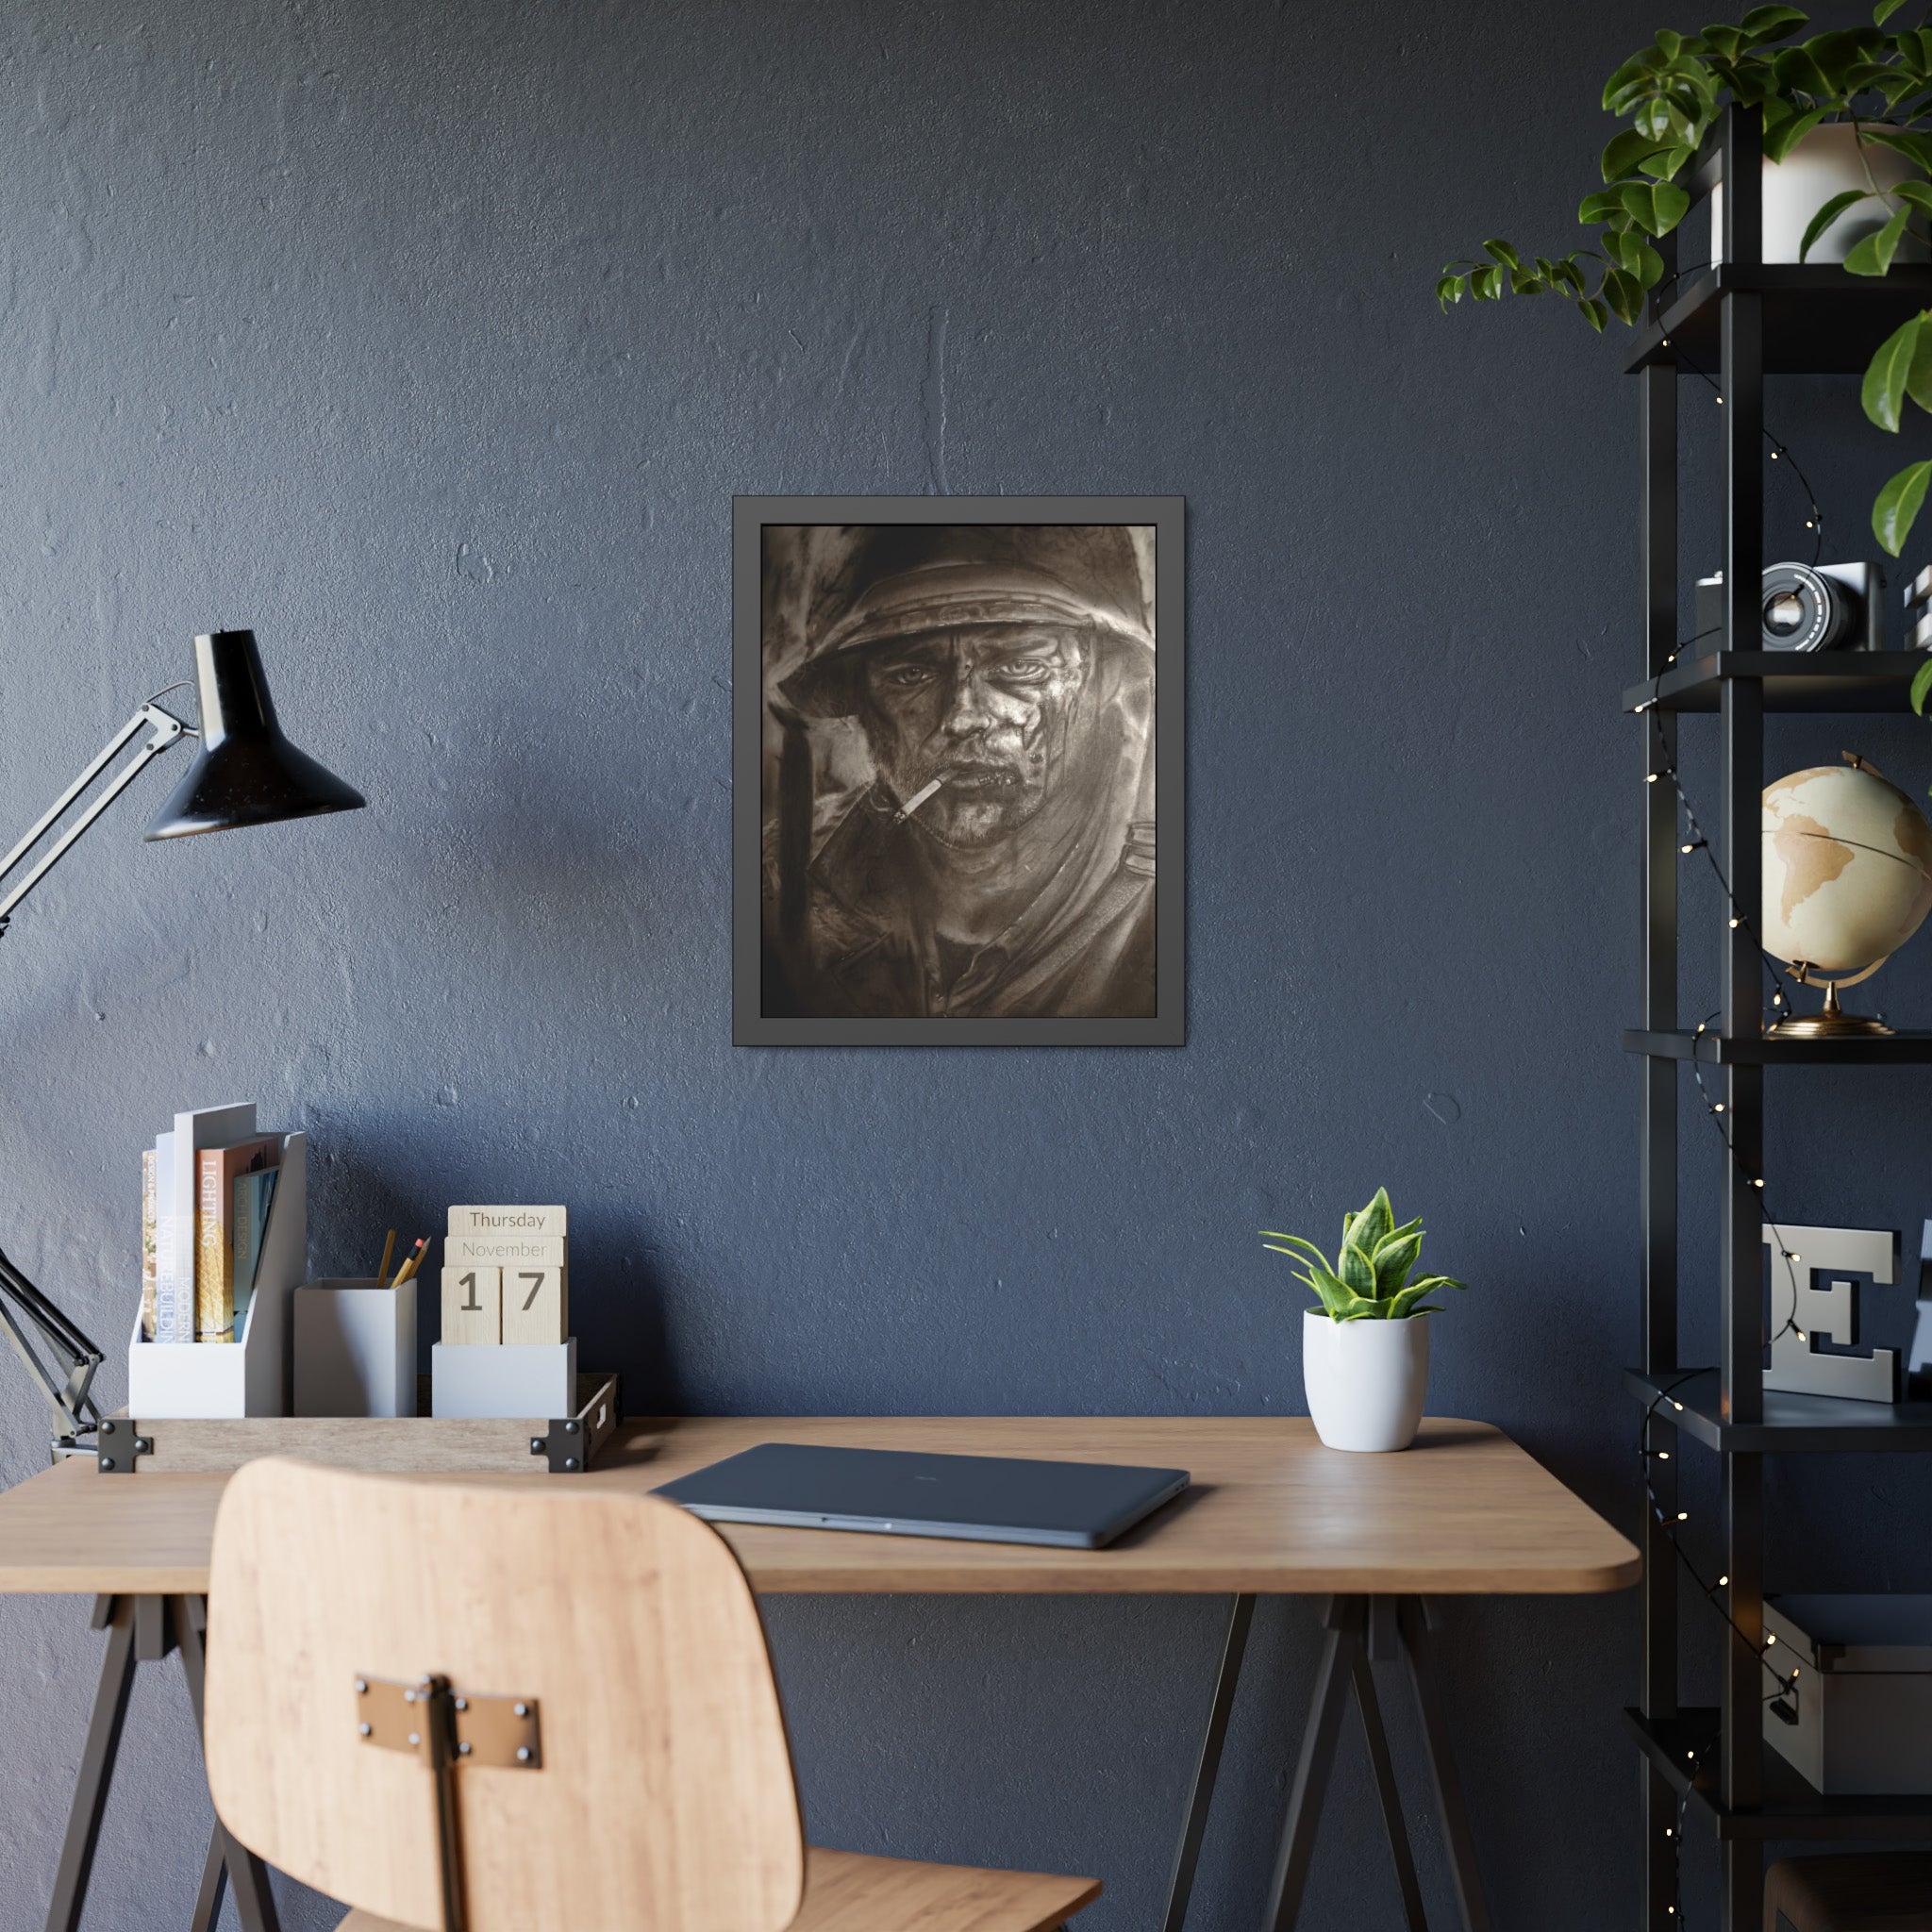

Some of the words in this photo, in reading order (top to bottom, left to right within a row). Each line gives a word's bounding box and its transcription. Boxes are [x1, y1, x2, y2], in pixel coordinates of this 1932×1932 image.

[147, 1155, 156, 1183] DESIGN
[201, 1160, 217, 1247] LIGHTING
[470, 1212, 546, 1230] Thursday
[237, 1216, 248, 1259] DESIGN
[462, 1241, 548, 1257] November
[177, 1276, 192, 1341] MODERN
[1762, 1224, 1894, 1403] E
